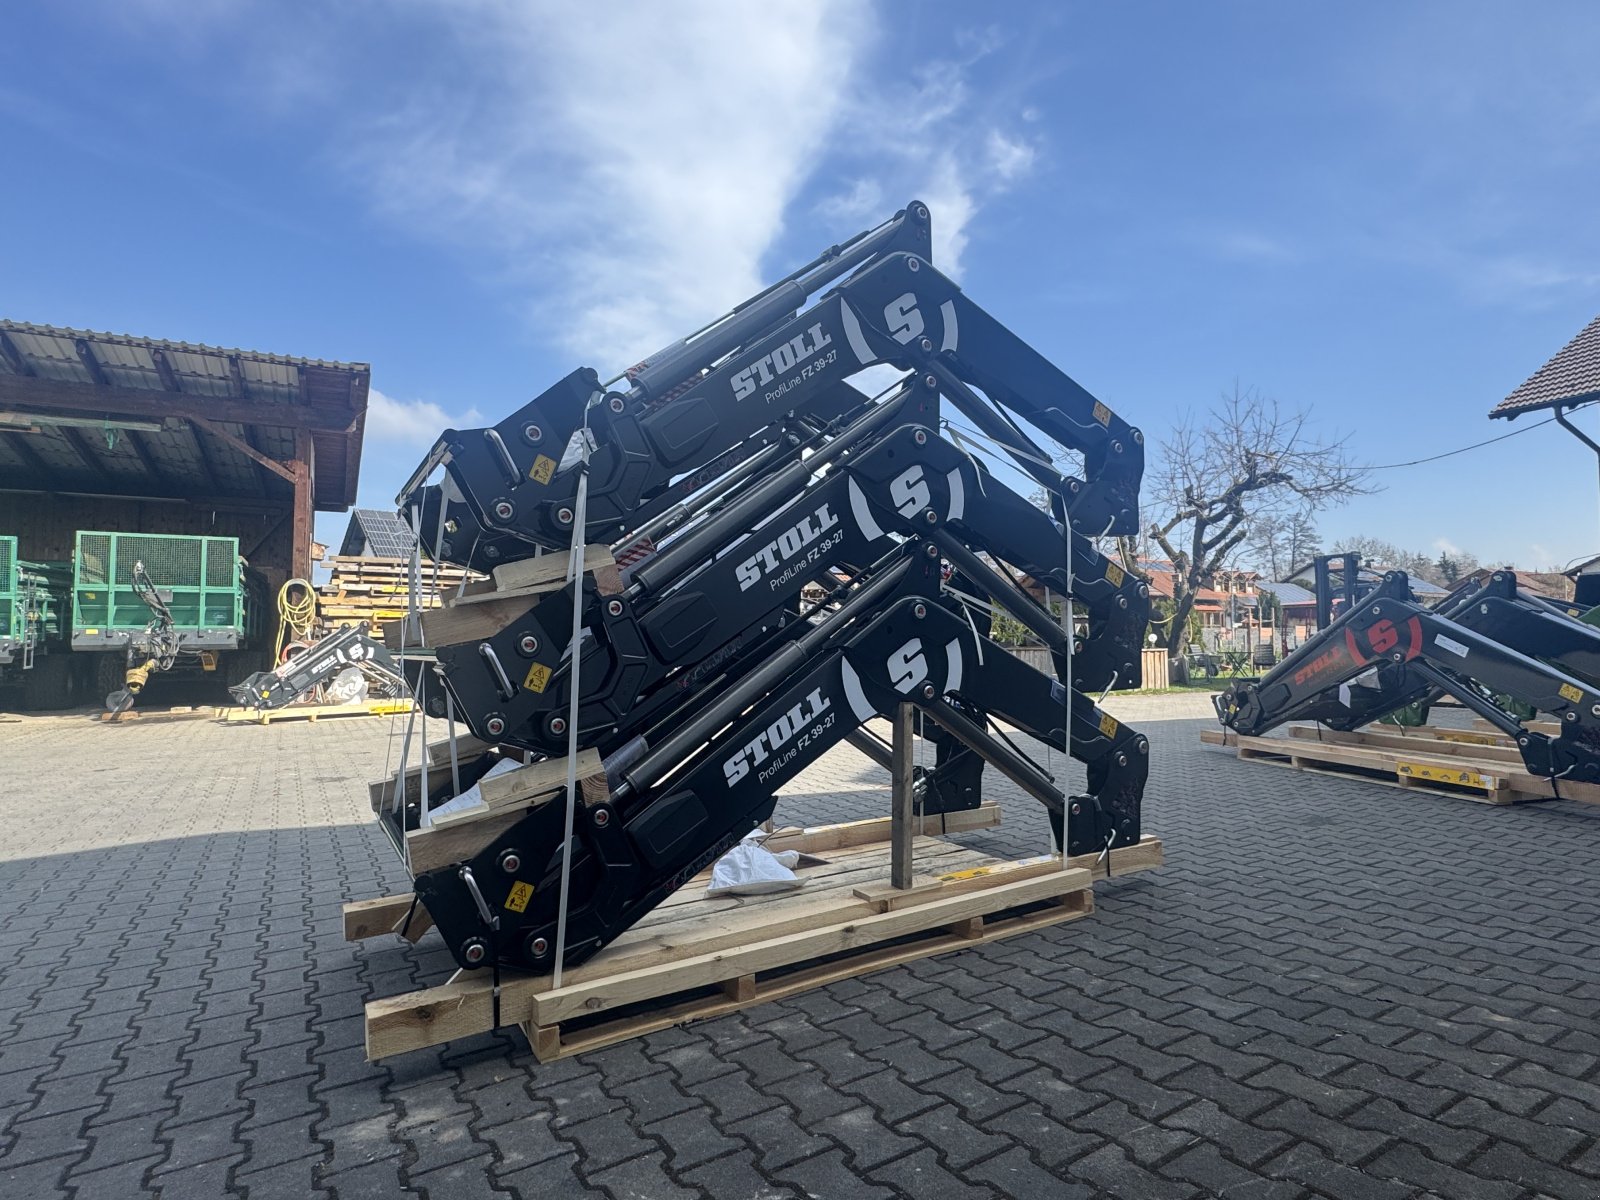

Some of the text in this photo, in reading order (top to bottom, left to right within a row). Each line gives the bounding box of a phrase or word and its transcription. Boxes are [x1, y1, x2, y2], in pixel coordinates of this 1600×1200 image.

[884, 292, 925, 345] S
[730, 322, 832, 402] STOLL
[765, 350, 837, 404] ProfiLine FZ 39-27
[890, 465, 930, 519] S
[735, 503, 838, 592] STOLL
[769, 529, 844, 591] ProfiLine FZ 39-27
[1367, 619, 1398, 653] S
[887, 637, 928, 694] S
[1294, 646, 1342, 685] STOLL
[722, 686, 831, 788] STOLL
[758, 712, 836, 784] ProfiLine FZ 39-27
